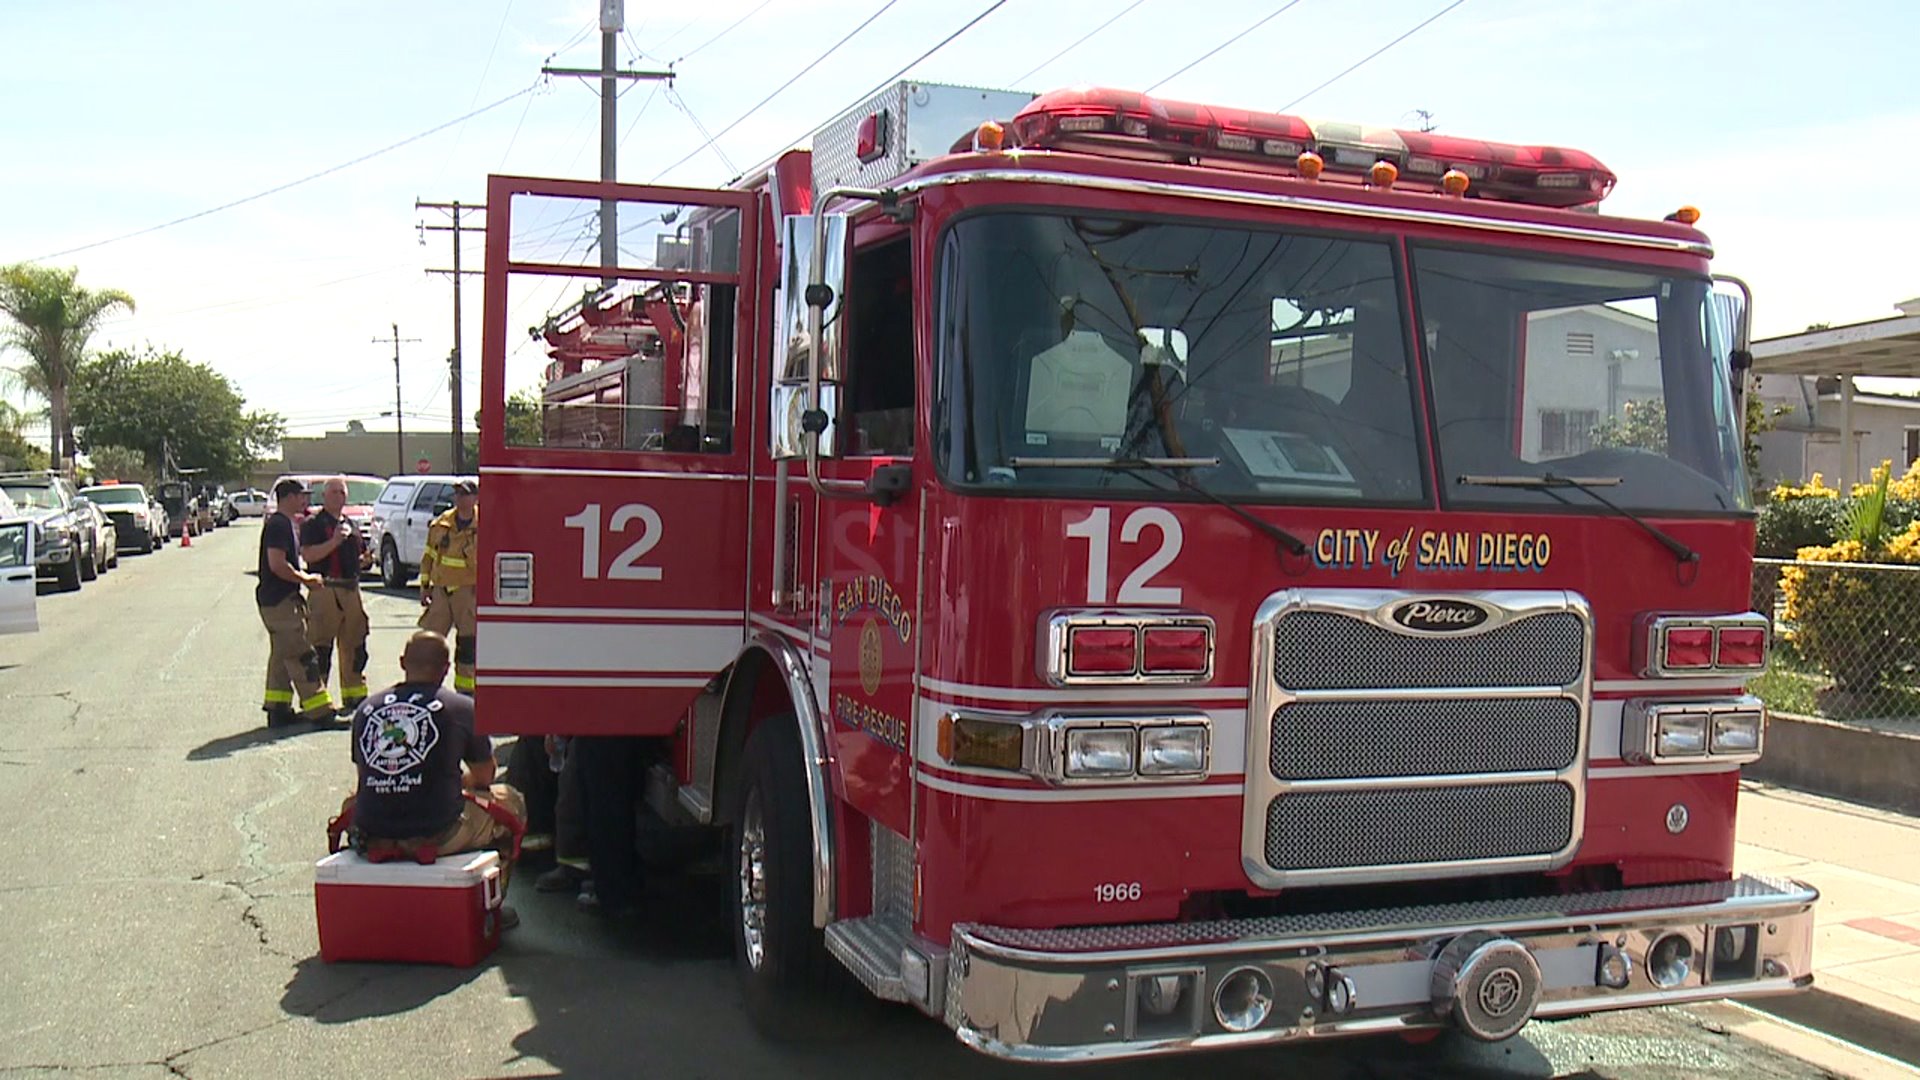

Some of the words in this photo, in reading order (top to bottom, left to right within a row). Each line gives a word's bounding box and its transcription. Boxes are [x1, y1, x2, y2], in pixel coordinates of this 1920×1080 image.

[564, 503, 663, 581] 12
[1065, 506, 1183, 605] 12
[1315, 528, 1380, 567] CITY
[1385, 526, 1414, 575] of
[1417, 531, 1471, 569] SAN
[1477, 533, 1551, 570] DIEGO
[838, 575, 864, 622] SAN
[867, 575, 912, 643] DIEGO
[1403, 602, 1476, 626] Pierce
[837, 692, 907, 750] FIRE-RESCUE
[1093, 882, 1141, 902] 1966
